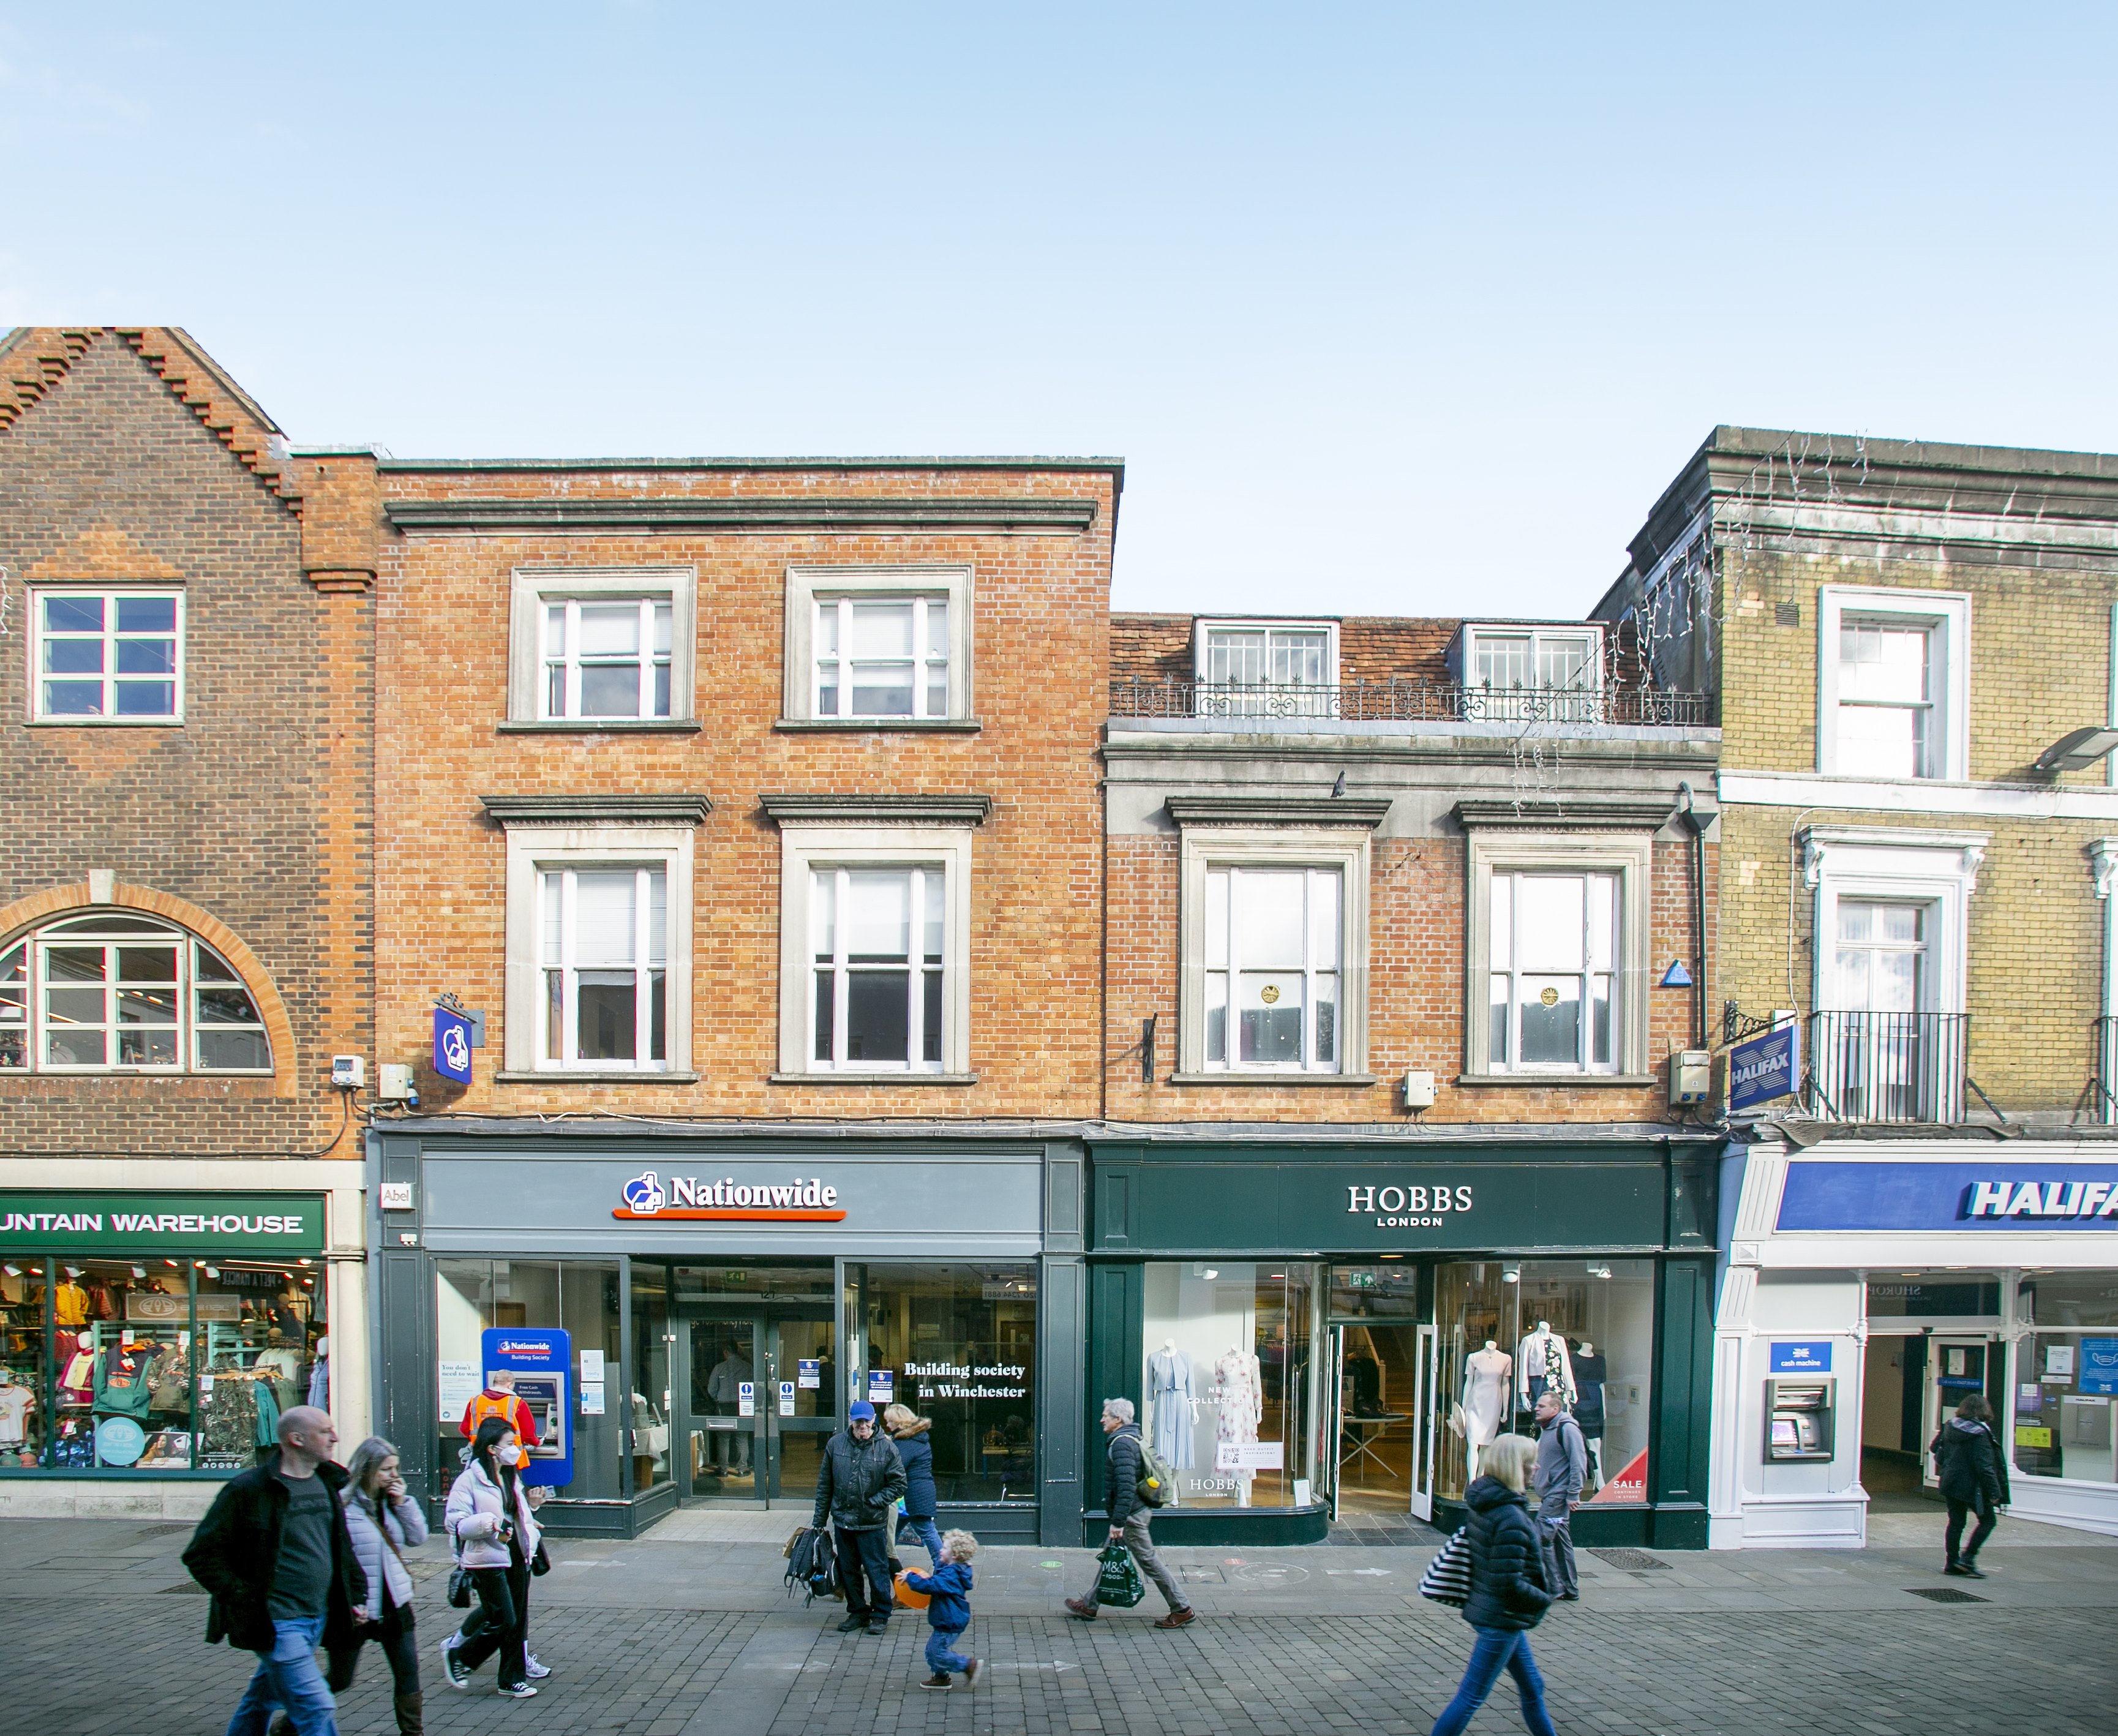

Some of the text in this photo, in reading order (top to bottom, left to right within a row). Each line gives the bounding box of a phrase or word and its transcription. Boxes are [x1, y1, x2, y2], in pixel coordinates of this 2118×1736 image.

[1732, 1052, 1789, 1086] HALIFAX
[383, 1189, 409, 1201] Abel
[672, 1177, 838, 1207] Nationwide
[1348, 1186, 1472, 1212] HOBBS
[1967, 1181, 2118, 1216] HALIFA
[111, 1214, 303, 1233] WAREHOUSE
[1376, 1217, 1442, 1227] LONDON
[904, 1362, 1026, 1379] Building society
[919, 1384, 1026, 1397] in Winchester
[1190, 1479, 1244, 1490] HOBBS
[1102, 1561, 1125, 1574] M&S
